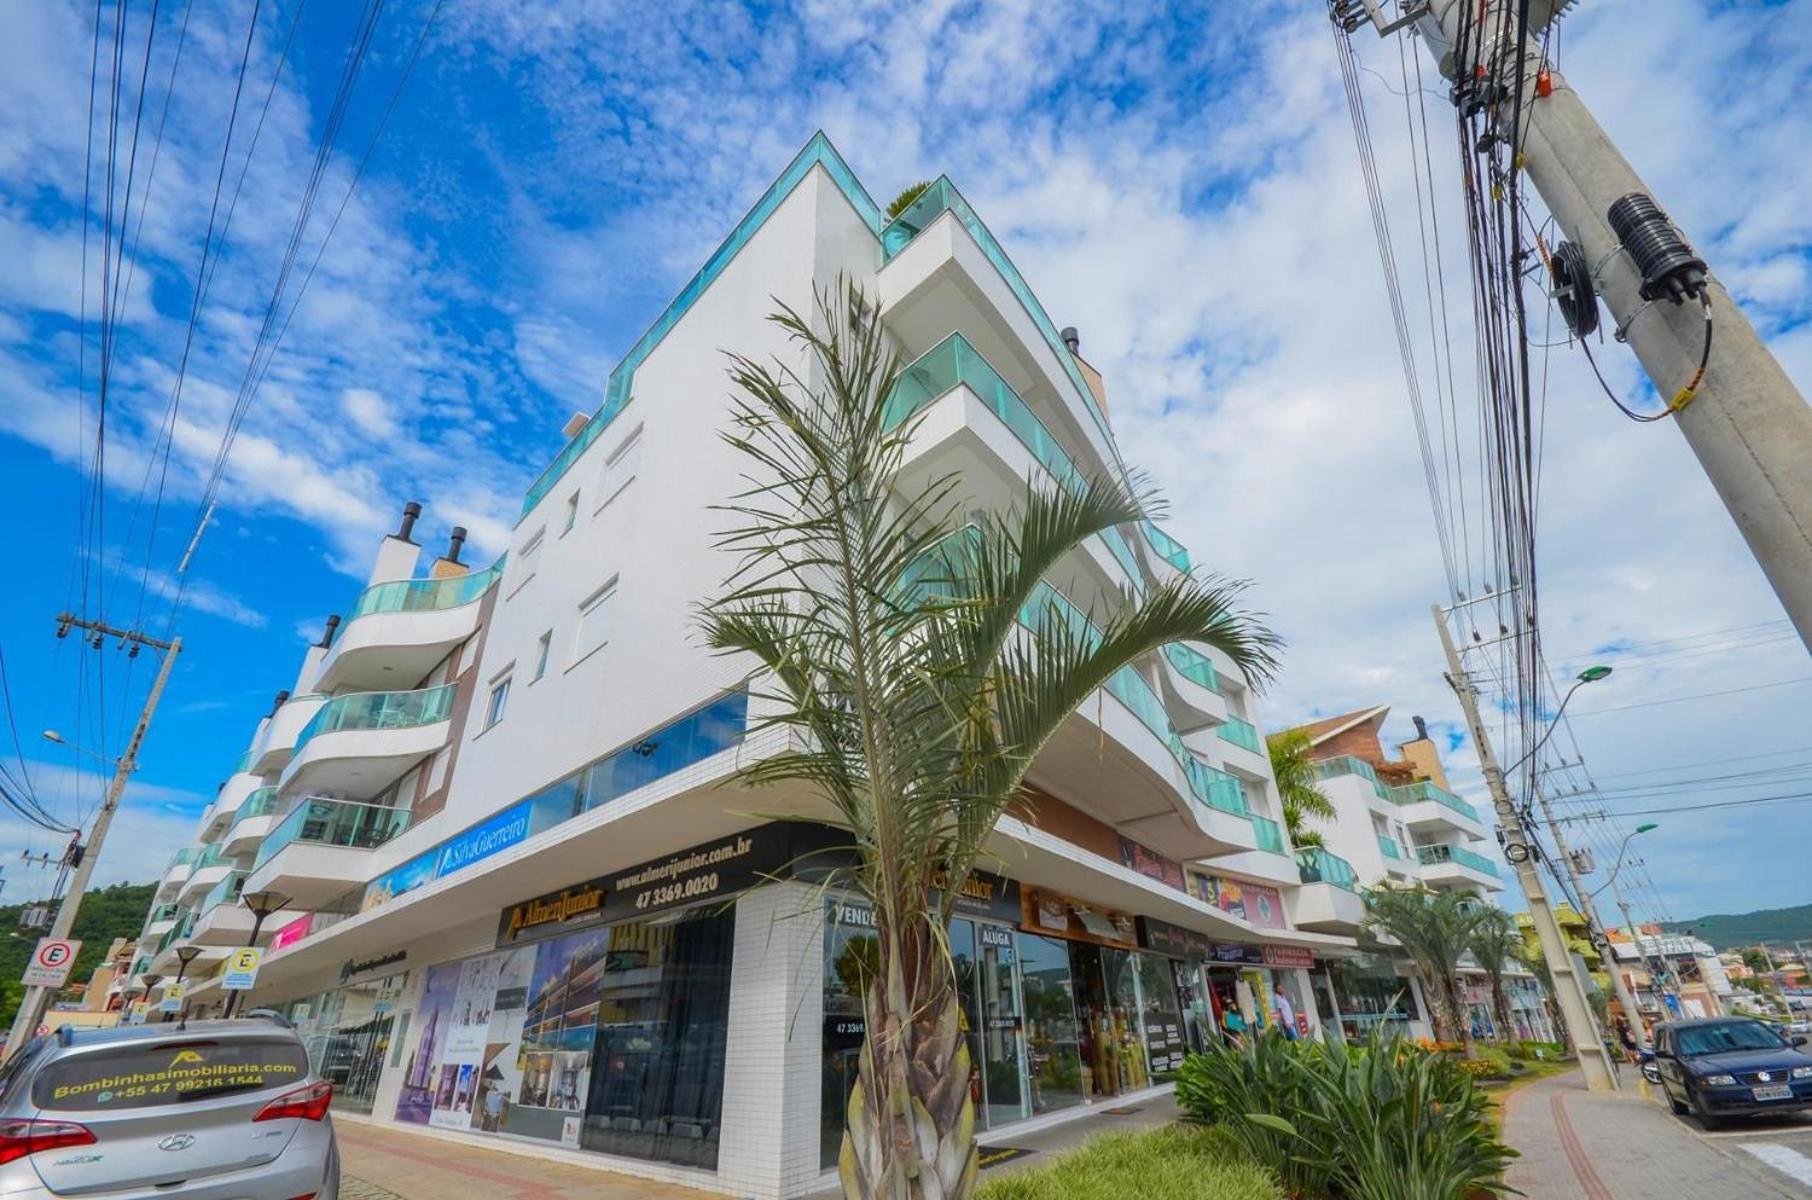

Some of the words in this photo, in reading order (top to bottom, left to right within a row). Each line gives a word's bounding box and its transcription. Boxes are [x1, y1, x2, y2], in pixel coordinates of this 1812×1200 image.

[615, 836, 752, 891] www.almerijunior.com.br
[635, 891, 651, 909] 47
[652, 872, 718, 905] 3369.0020
[983, 930, 1010, 946] ALUGA
[47, 947, 63, 962] E
[54, 1063, 296, 1099] Bombinhasimobiliaria.com
[115, 1086, 146, 1098] +55
[151, 1082, 170, 1093] 47
